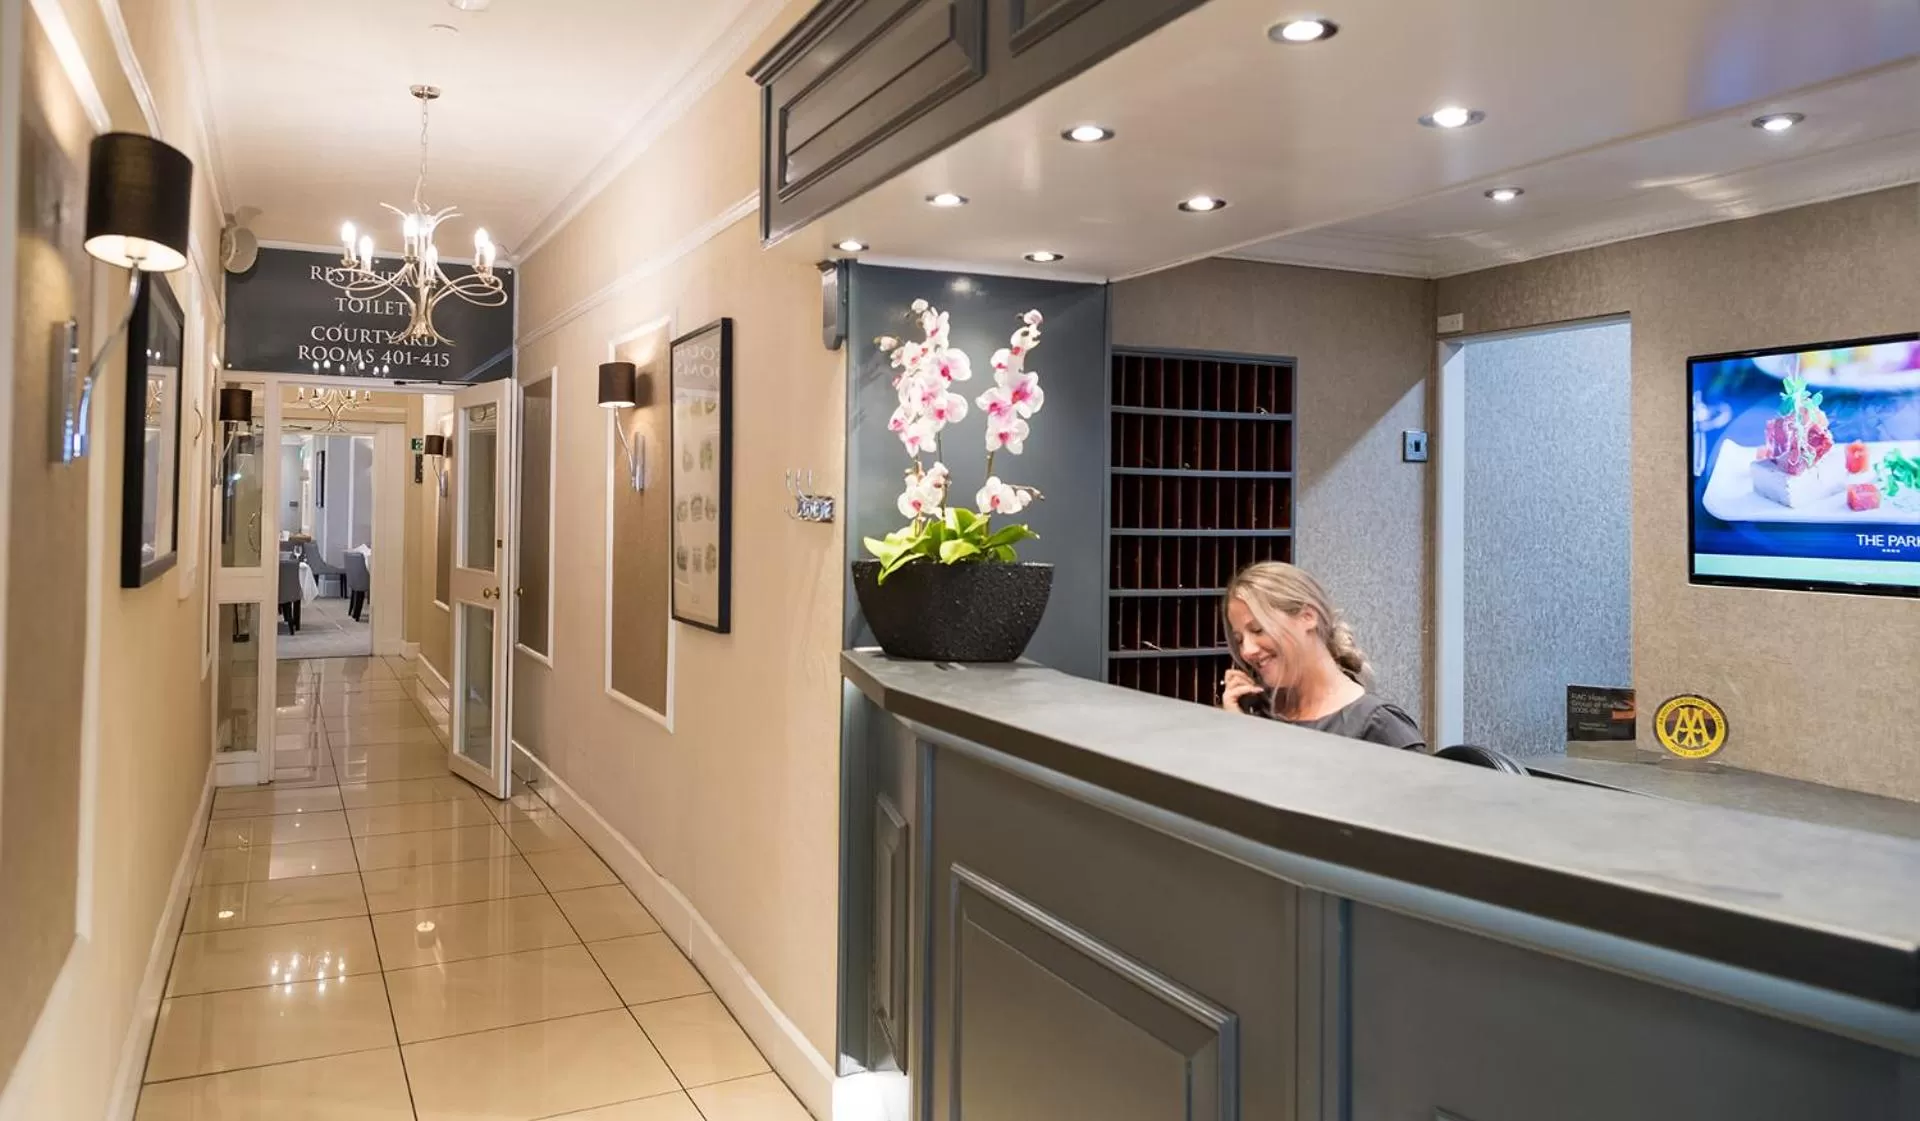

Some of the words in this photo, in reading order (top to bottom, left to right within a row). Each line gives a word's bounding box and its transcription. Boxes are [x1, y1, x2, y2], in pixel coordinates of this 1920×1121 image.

[310, 264, 433, 289] RESTAURA
[335, 297, 413, 317] TOILET
[299, 344, 375, 364] ROOMS
[381, 349, 450, 368] 401-415
[1855, 534, 1885, 547] THE
